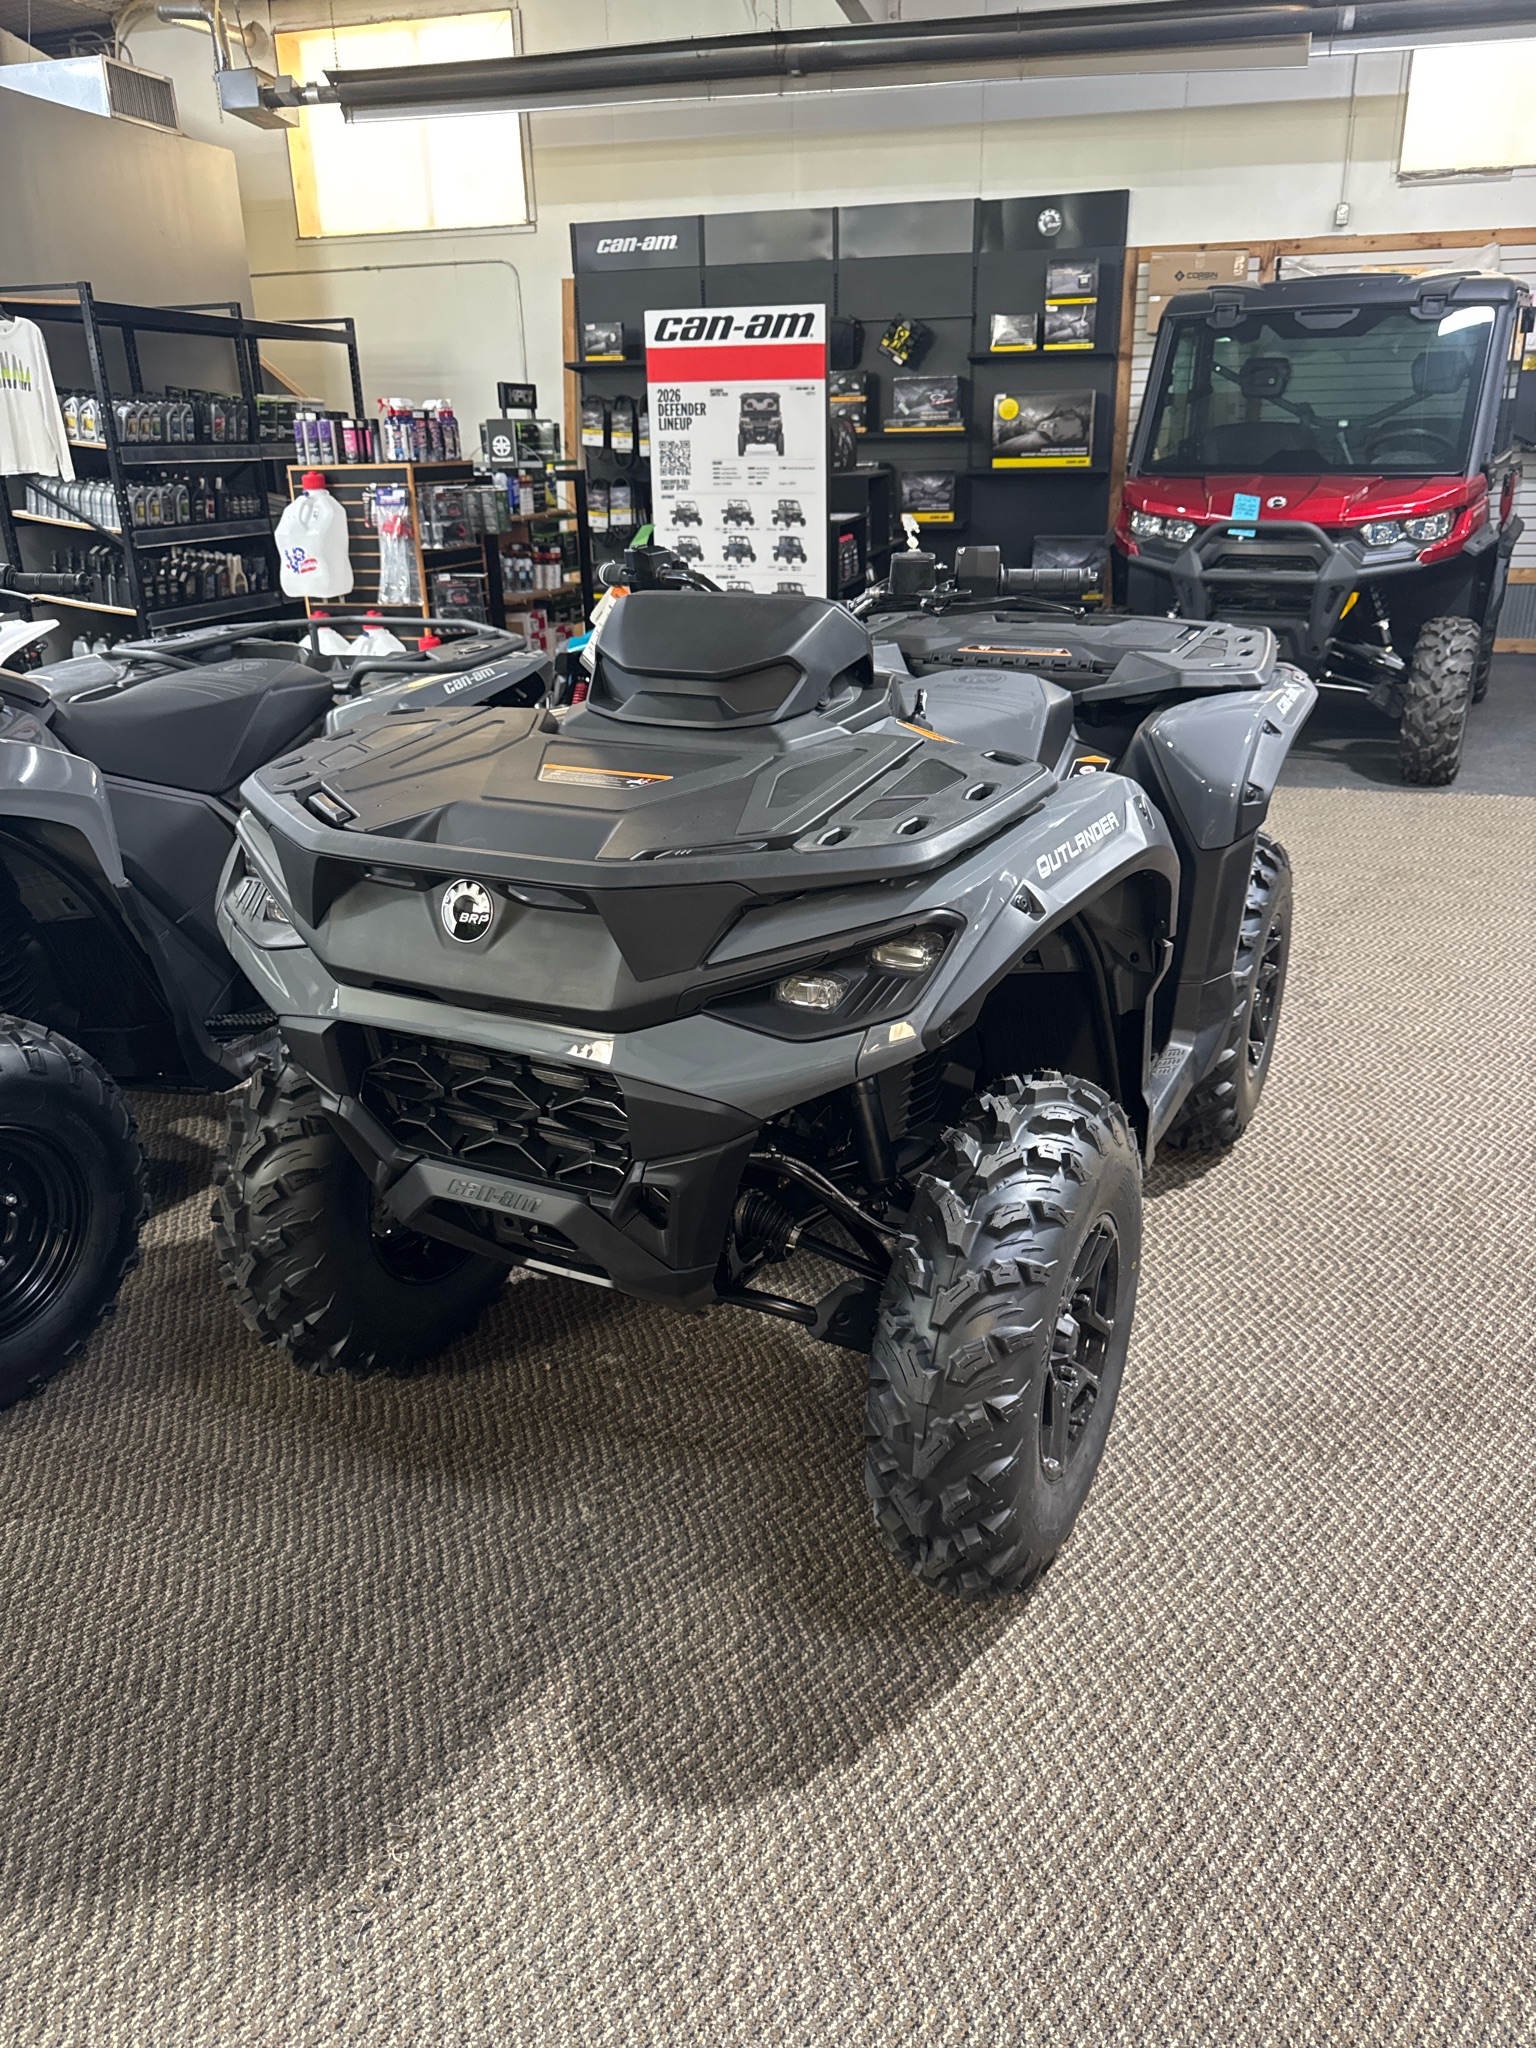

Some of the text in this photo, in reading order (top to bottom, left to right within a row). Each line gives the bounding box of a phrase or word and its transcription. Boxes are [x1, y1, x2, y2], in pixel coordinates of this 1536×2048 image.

[596, 234, 678, 254] can-am
[654, 312, 815, 342] can-am
[657, 389, 681, 402] 2026
[658, 402, 707, 417] DEFENDER
[658, 417, 693, 431] LINEUP
[443, 667, 496, 695] can-am
[1036, 811, 1120, 880] OUTLANDER
[459, 912, 490, 925] BRP
[447, 1179, 543, 1214] can-am
